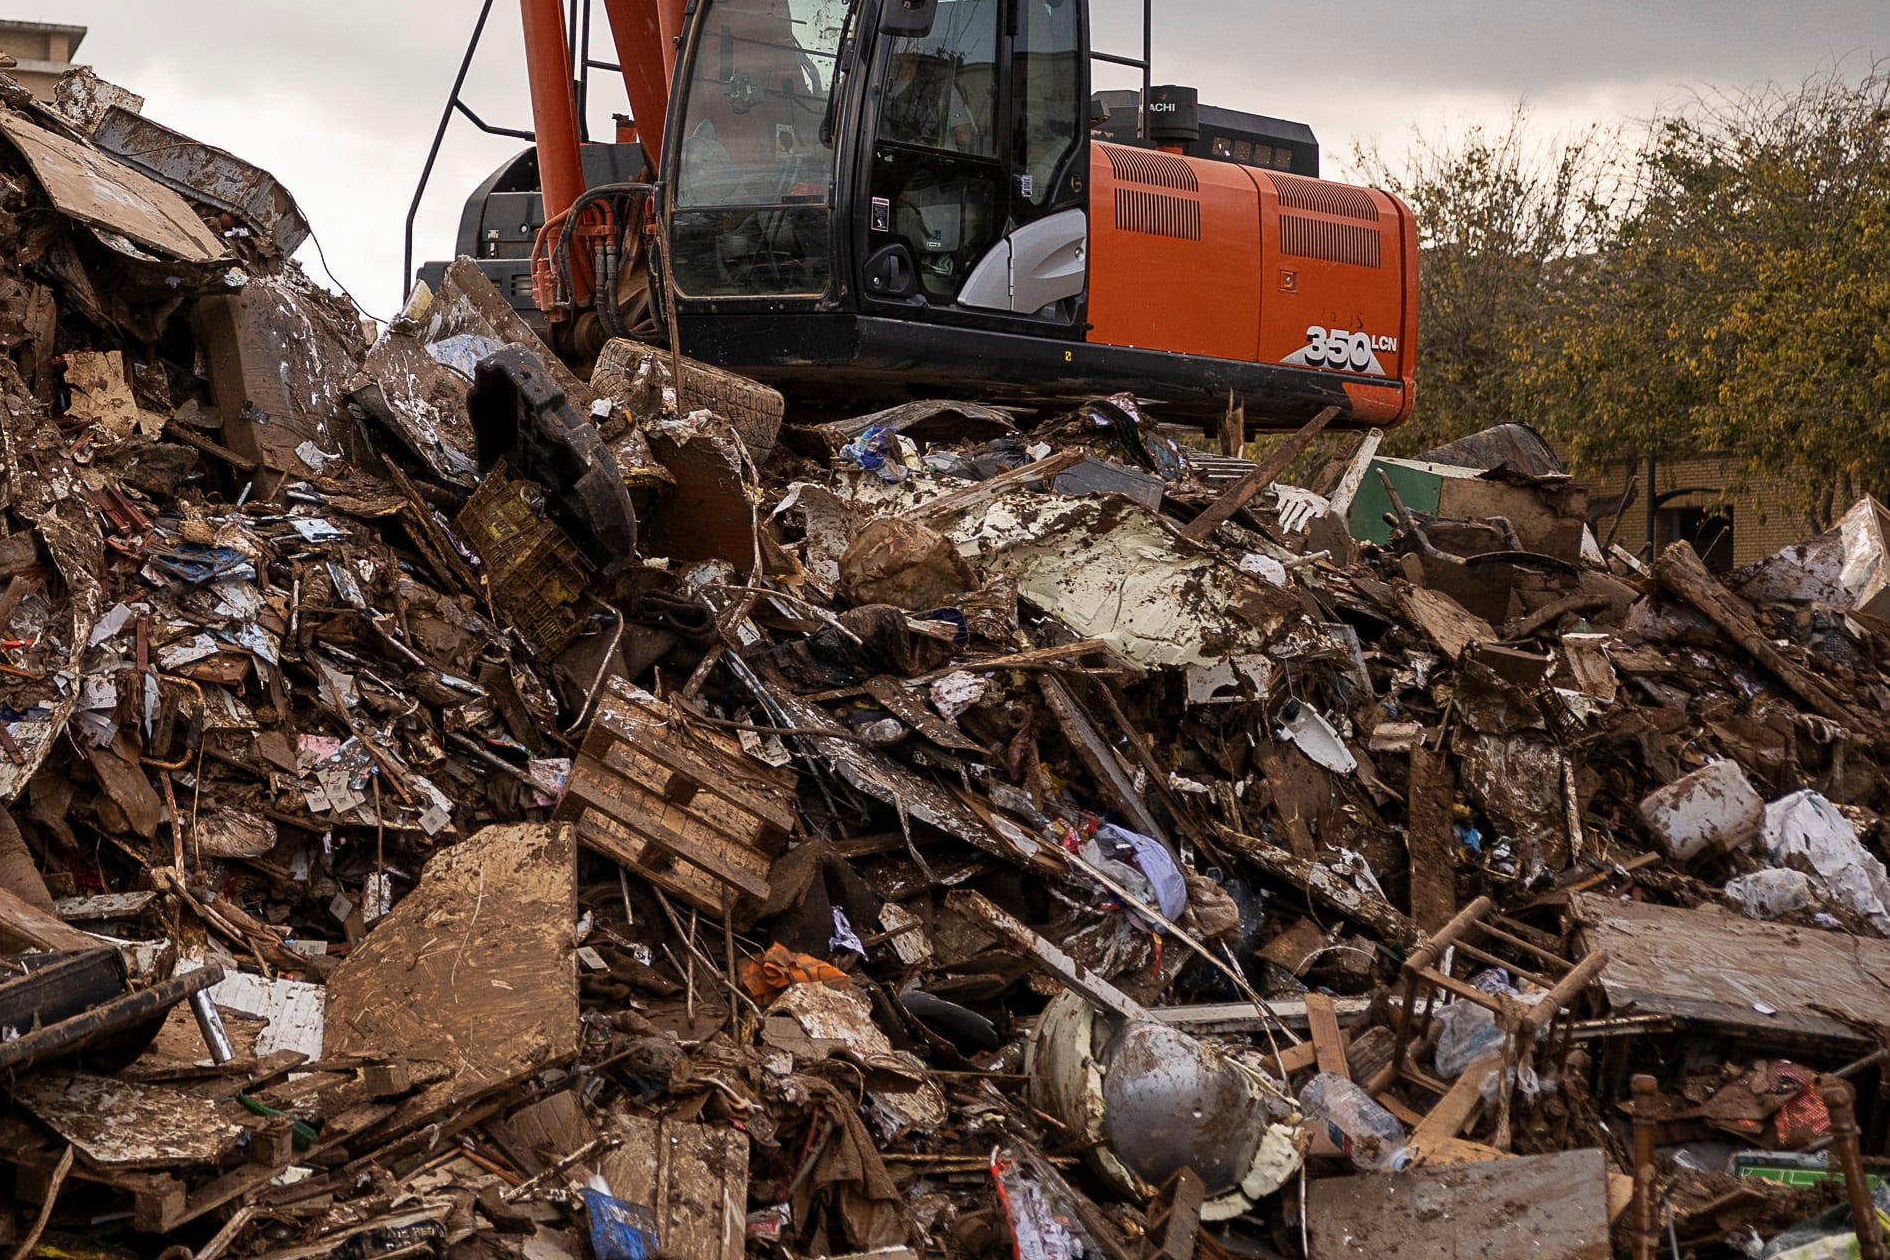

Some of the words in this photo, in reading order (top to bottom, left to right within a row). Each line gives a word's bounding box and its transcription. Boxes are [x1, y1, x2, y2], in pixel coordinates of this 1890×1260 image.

[1149, 103, 1176, 112] ACHI
[1305, 325, 1371, 370] 350
[1371, 334, 1398, 353] LCN
